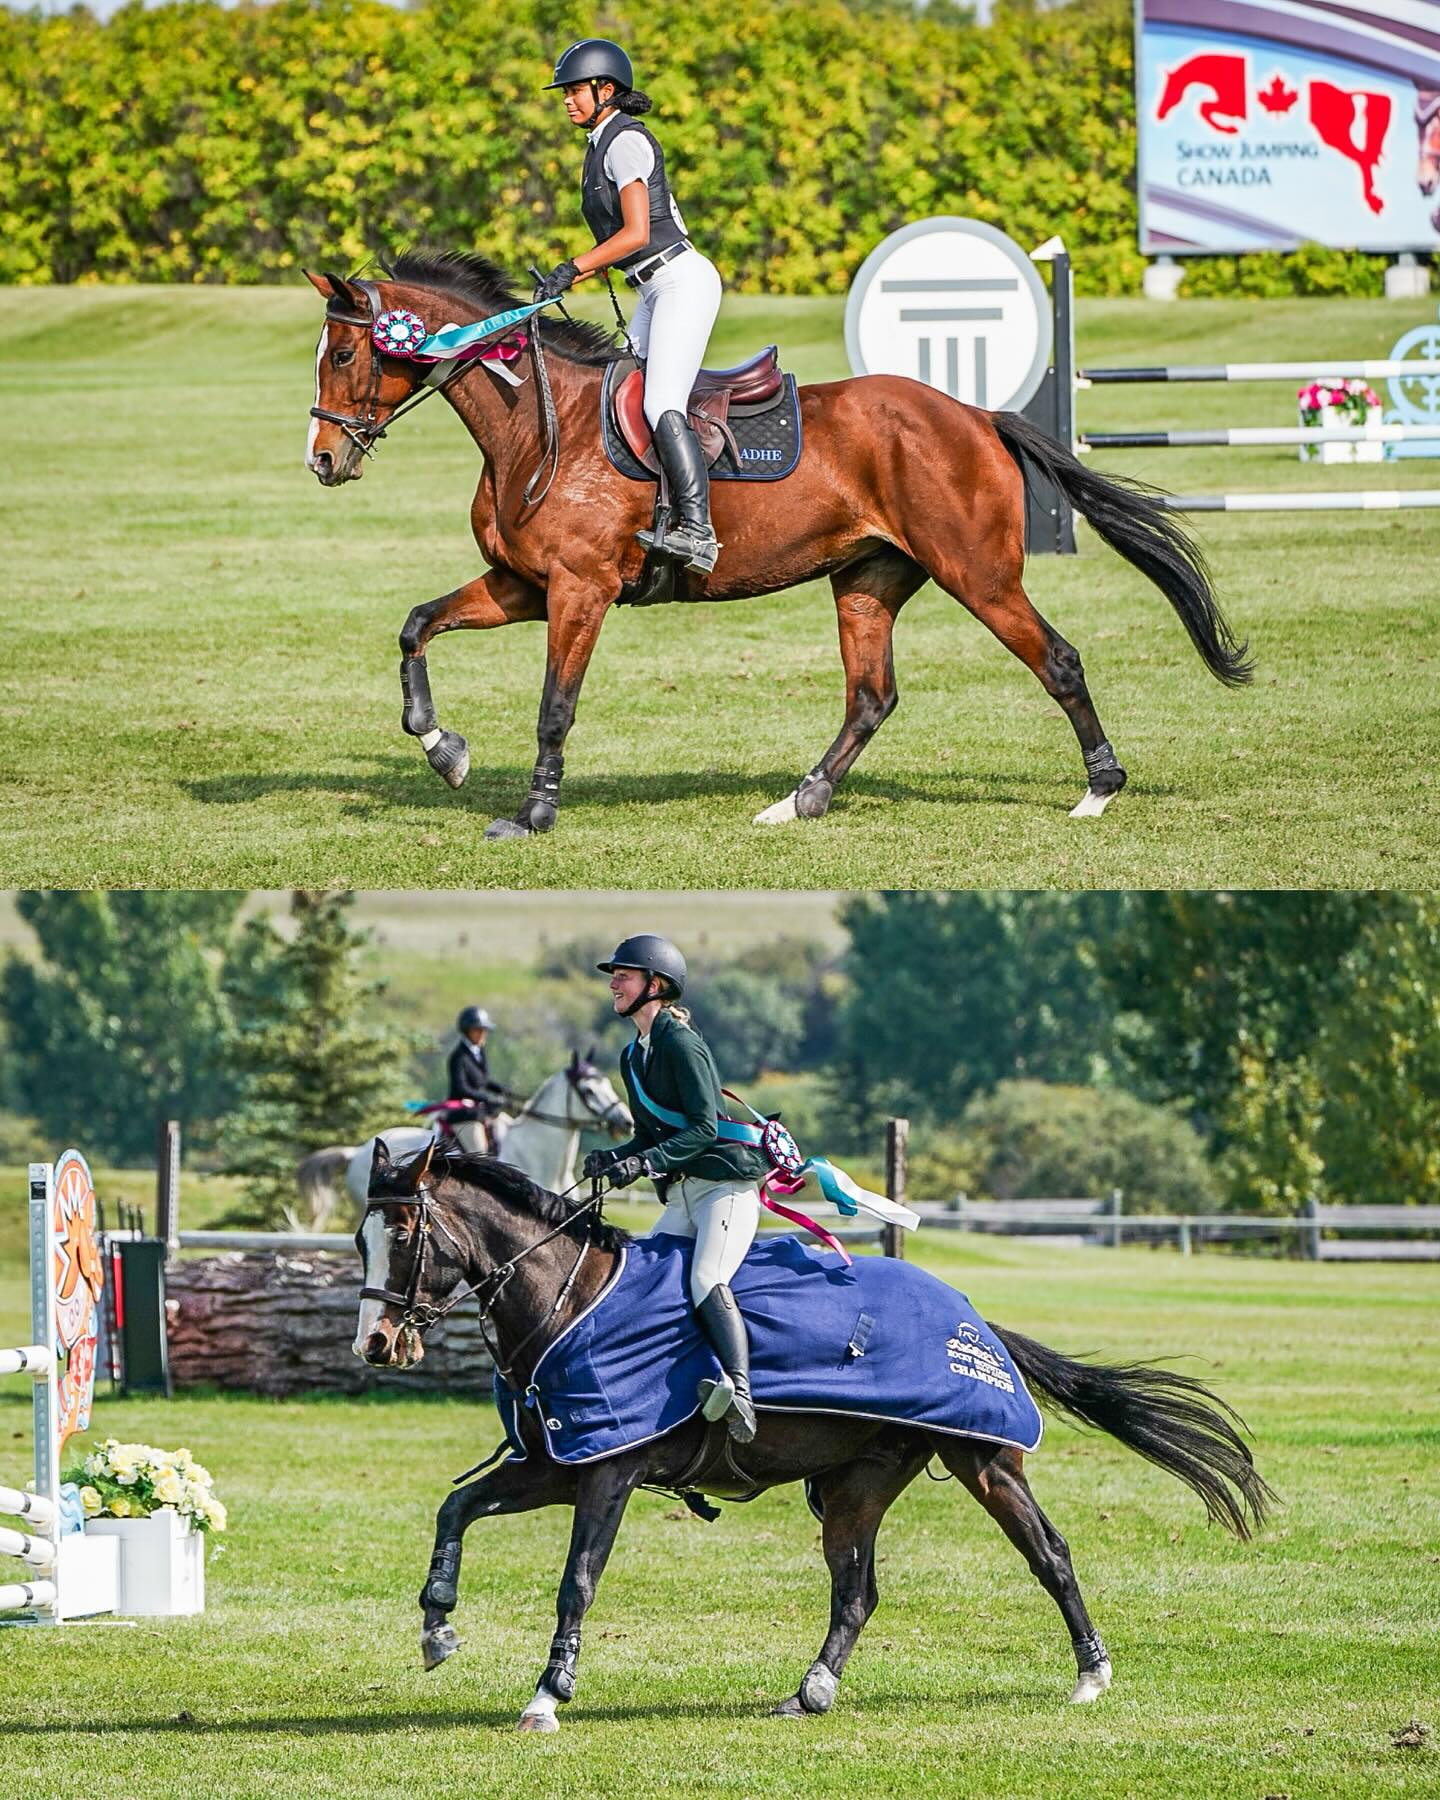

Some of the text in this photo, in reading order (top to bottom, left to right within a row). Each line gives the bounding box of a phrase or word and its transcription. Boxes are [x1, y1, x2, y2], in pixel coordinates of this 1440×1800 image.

[1177, 167, 1272, 186] CANADA
[740, 448, 783, 461] ADHE
[949, 1362, 1016, 1394] CHAMPION
